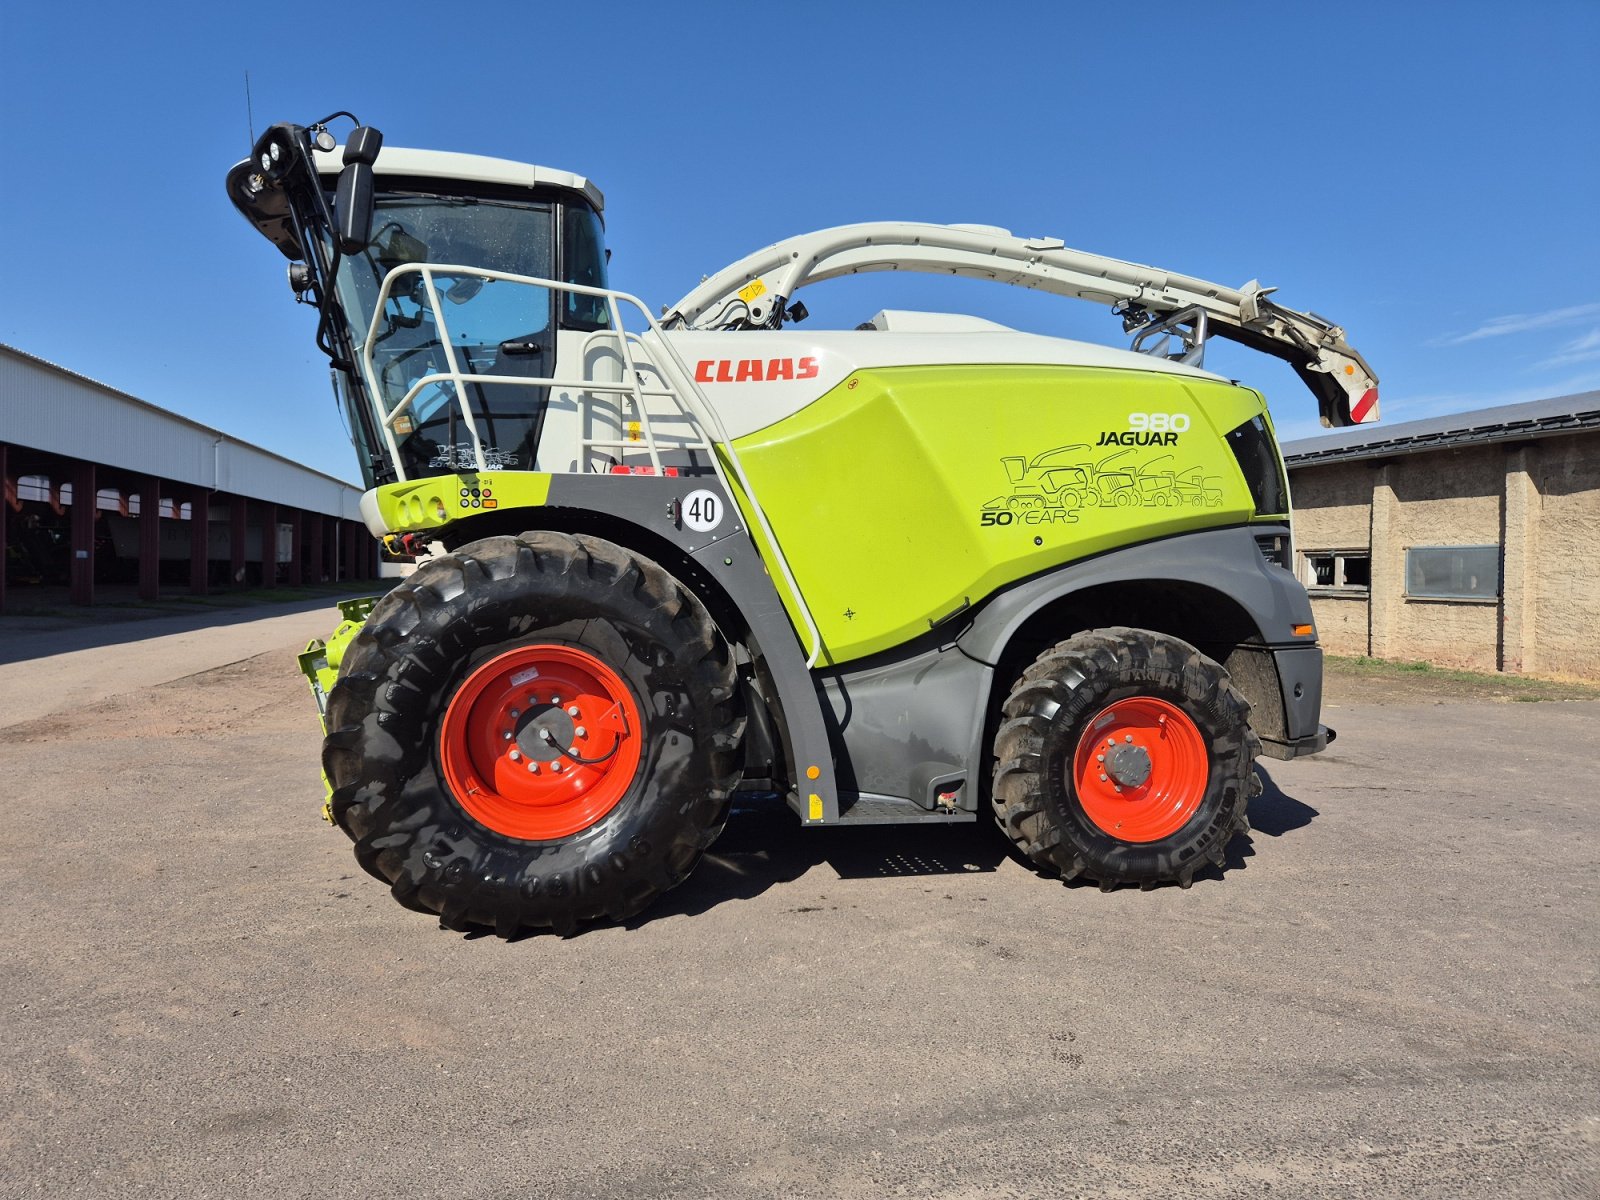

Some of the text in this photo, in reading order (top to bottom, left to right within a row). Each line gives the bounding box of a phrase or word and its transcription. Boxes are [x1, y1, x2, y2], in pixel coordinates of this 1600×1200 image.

[694, 357, 820, 383] CLAAS
[1128, 413, 1190, 433] 980
[1096, 432, 1178, 446] JAGUAR
[689, 497, 715, 522] 40
